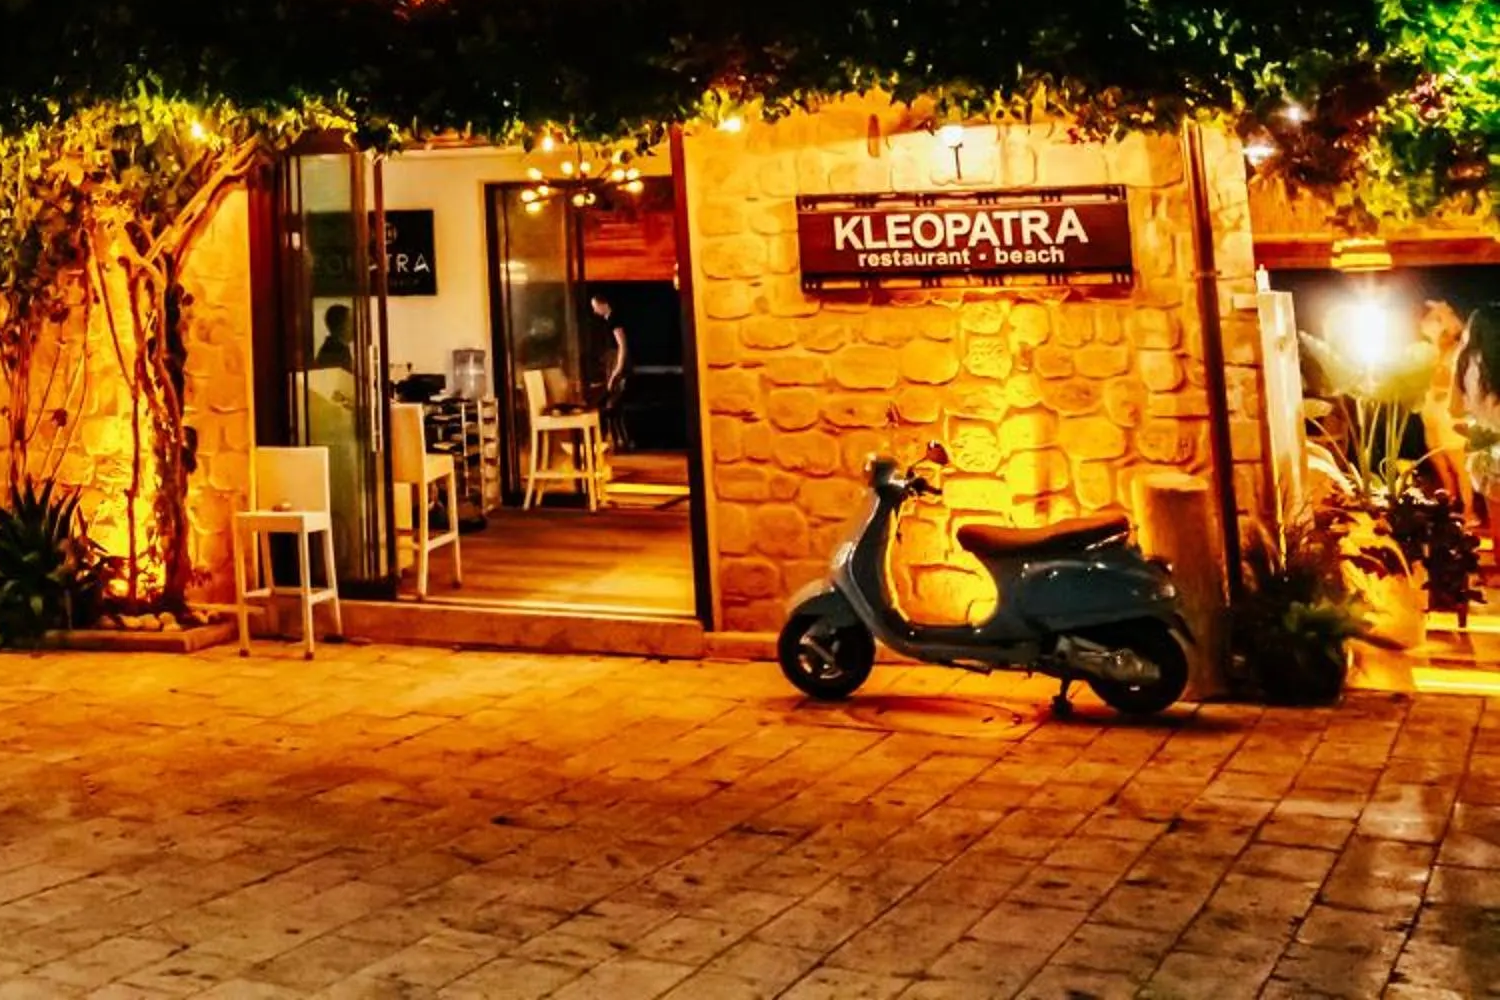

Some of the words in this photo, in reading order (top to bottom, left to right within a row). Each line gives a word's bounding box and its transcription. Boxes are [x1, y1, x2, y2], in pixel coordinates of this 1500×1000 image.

[834, 208, 1089, 250] KLEOPATRA
[858, 249, 971, 267] restaurant
[995, 246, 1065, 264] beach
